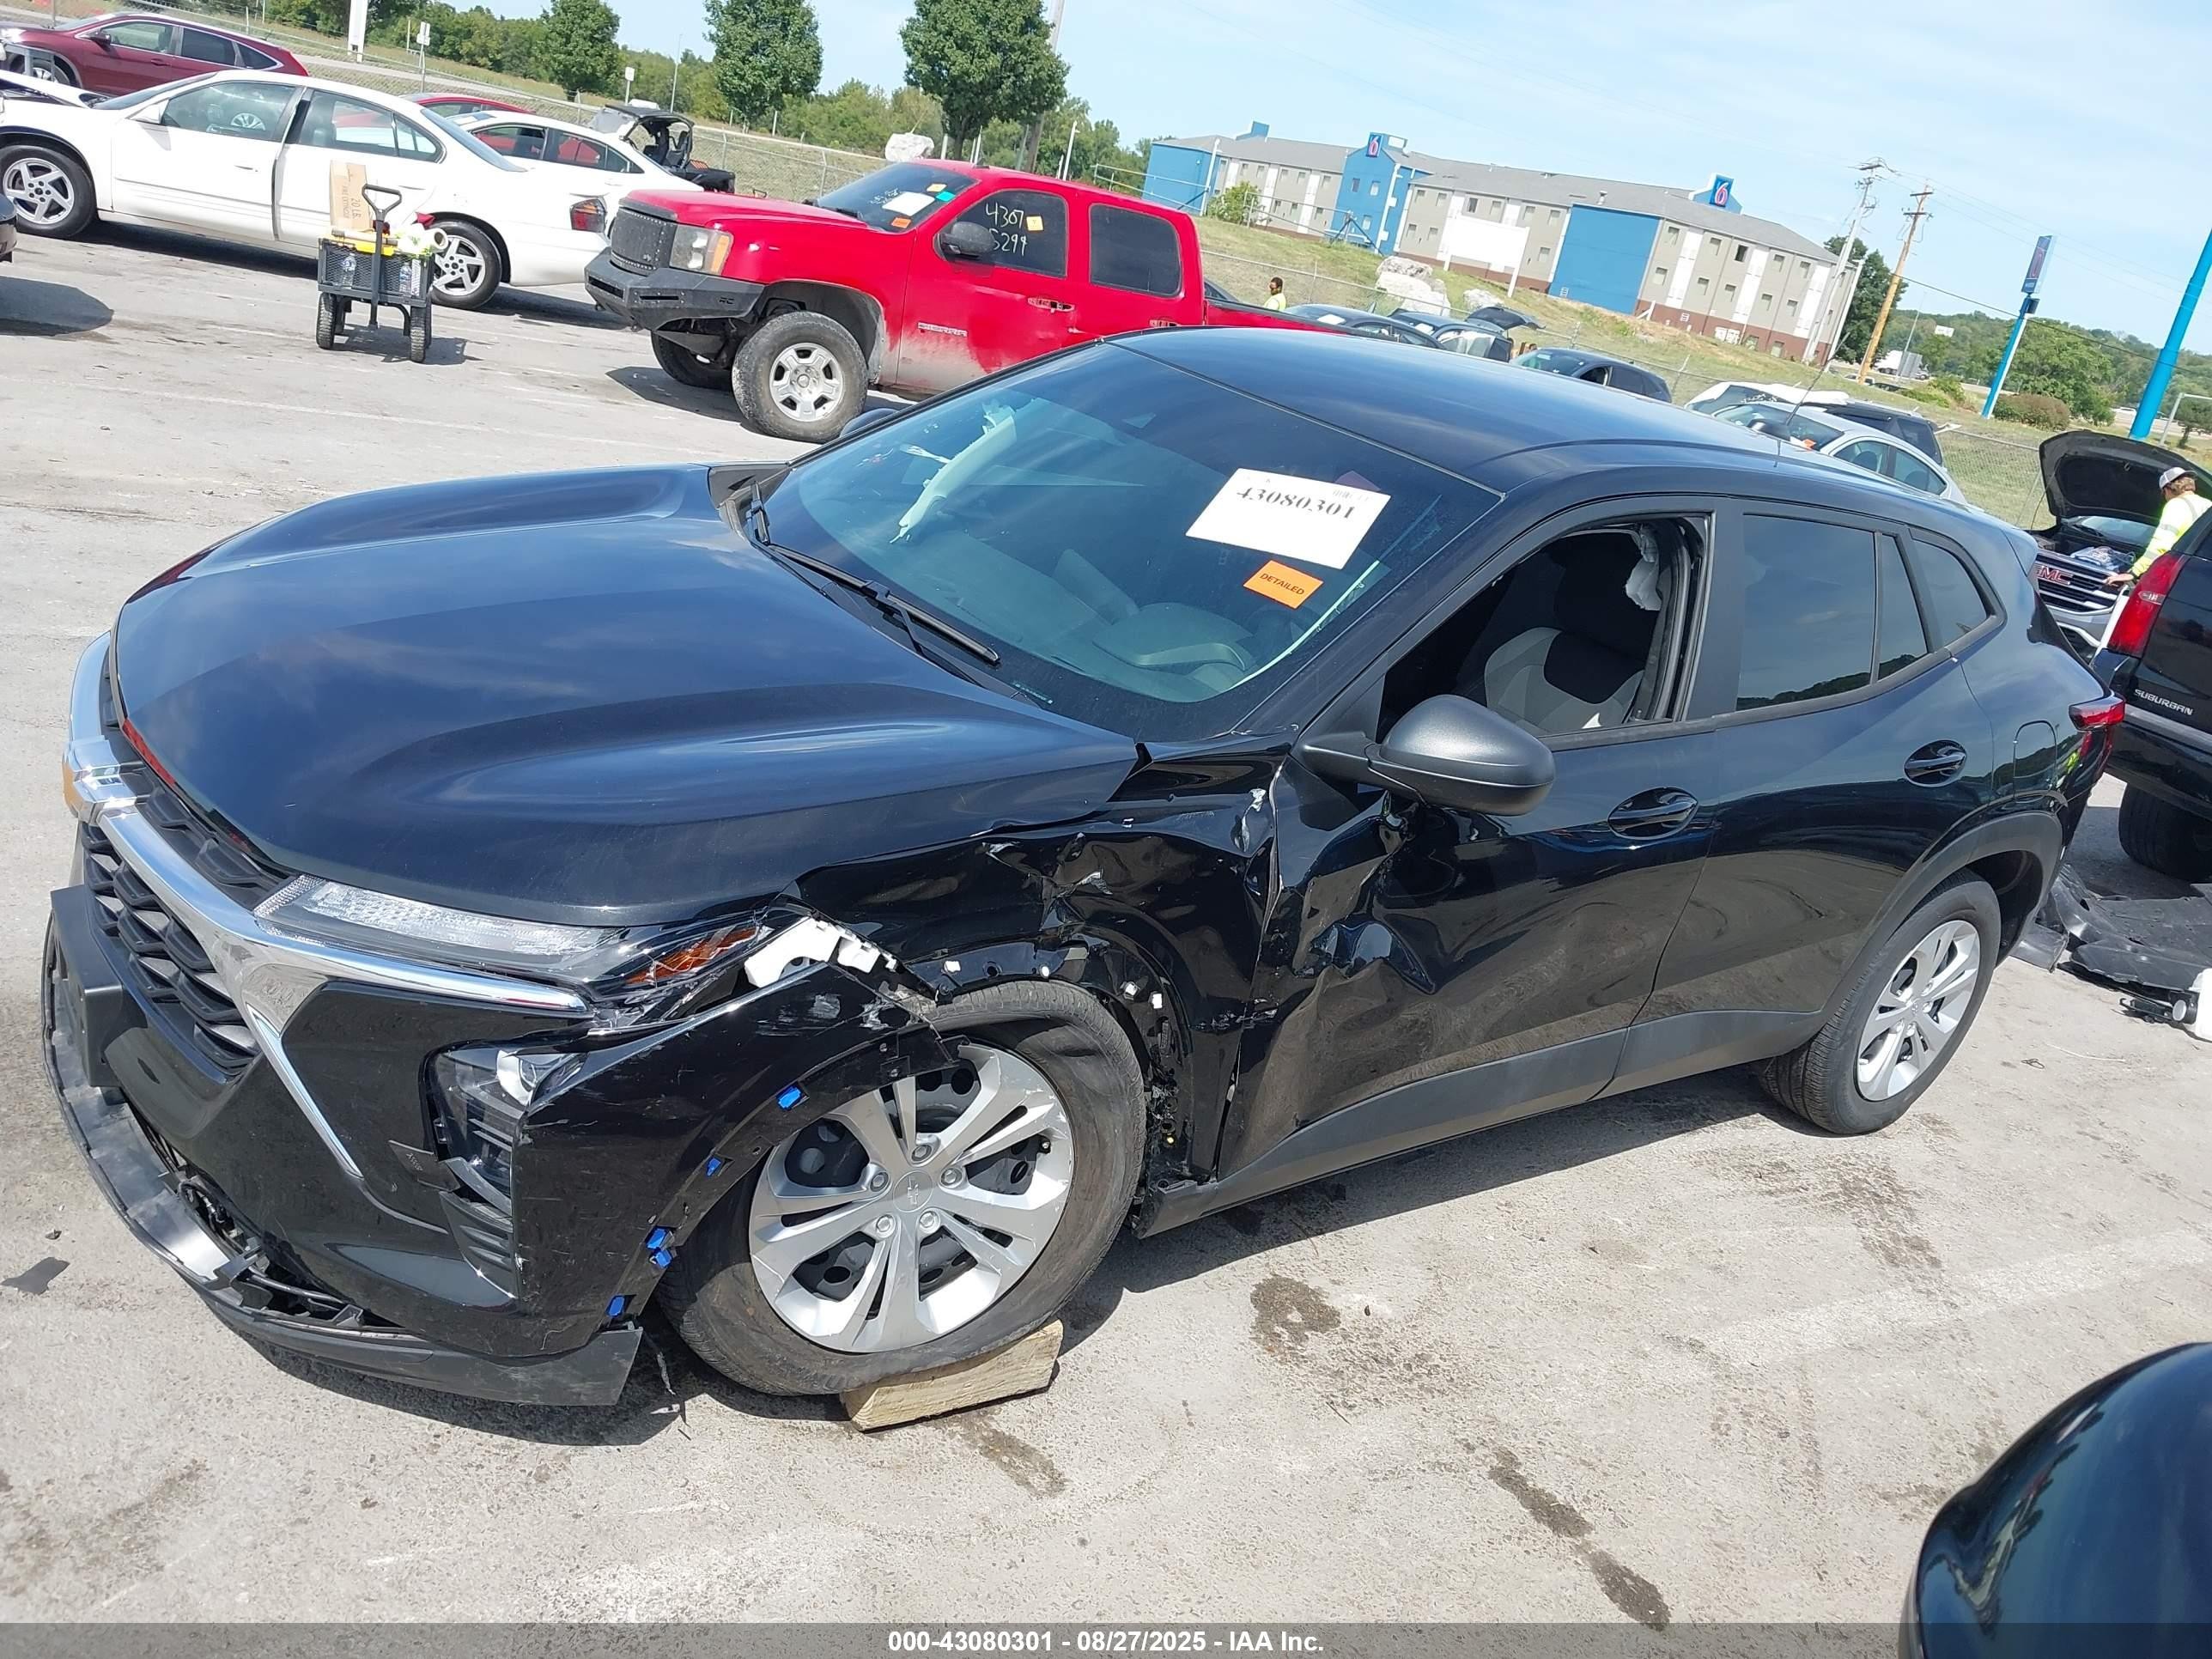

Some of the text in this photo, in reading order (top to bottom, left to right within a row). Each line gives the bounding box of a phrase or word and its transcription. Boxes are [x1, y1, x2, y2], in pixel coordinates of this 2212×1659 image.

[1369, 136, 1379, 155] 6
[1715, 181, 1729, 205] 6
[985, 202, 1024, 229] 4307
[917, 321, 968, 337] SIERRA
[1237, 487, 1356, 520] 43080301
[1259, 572, 1305, 596] DETAILED
[2134, 688, 2194, 716] SUBURBAN
